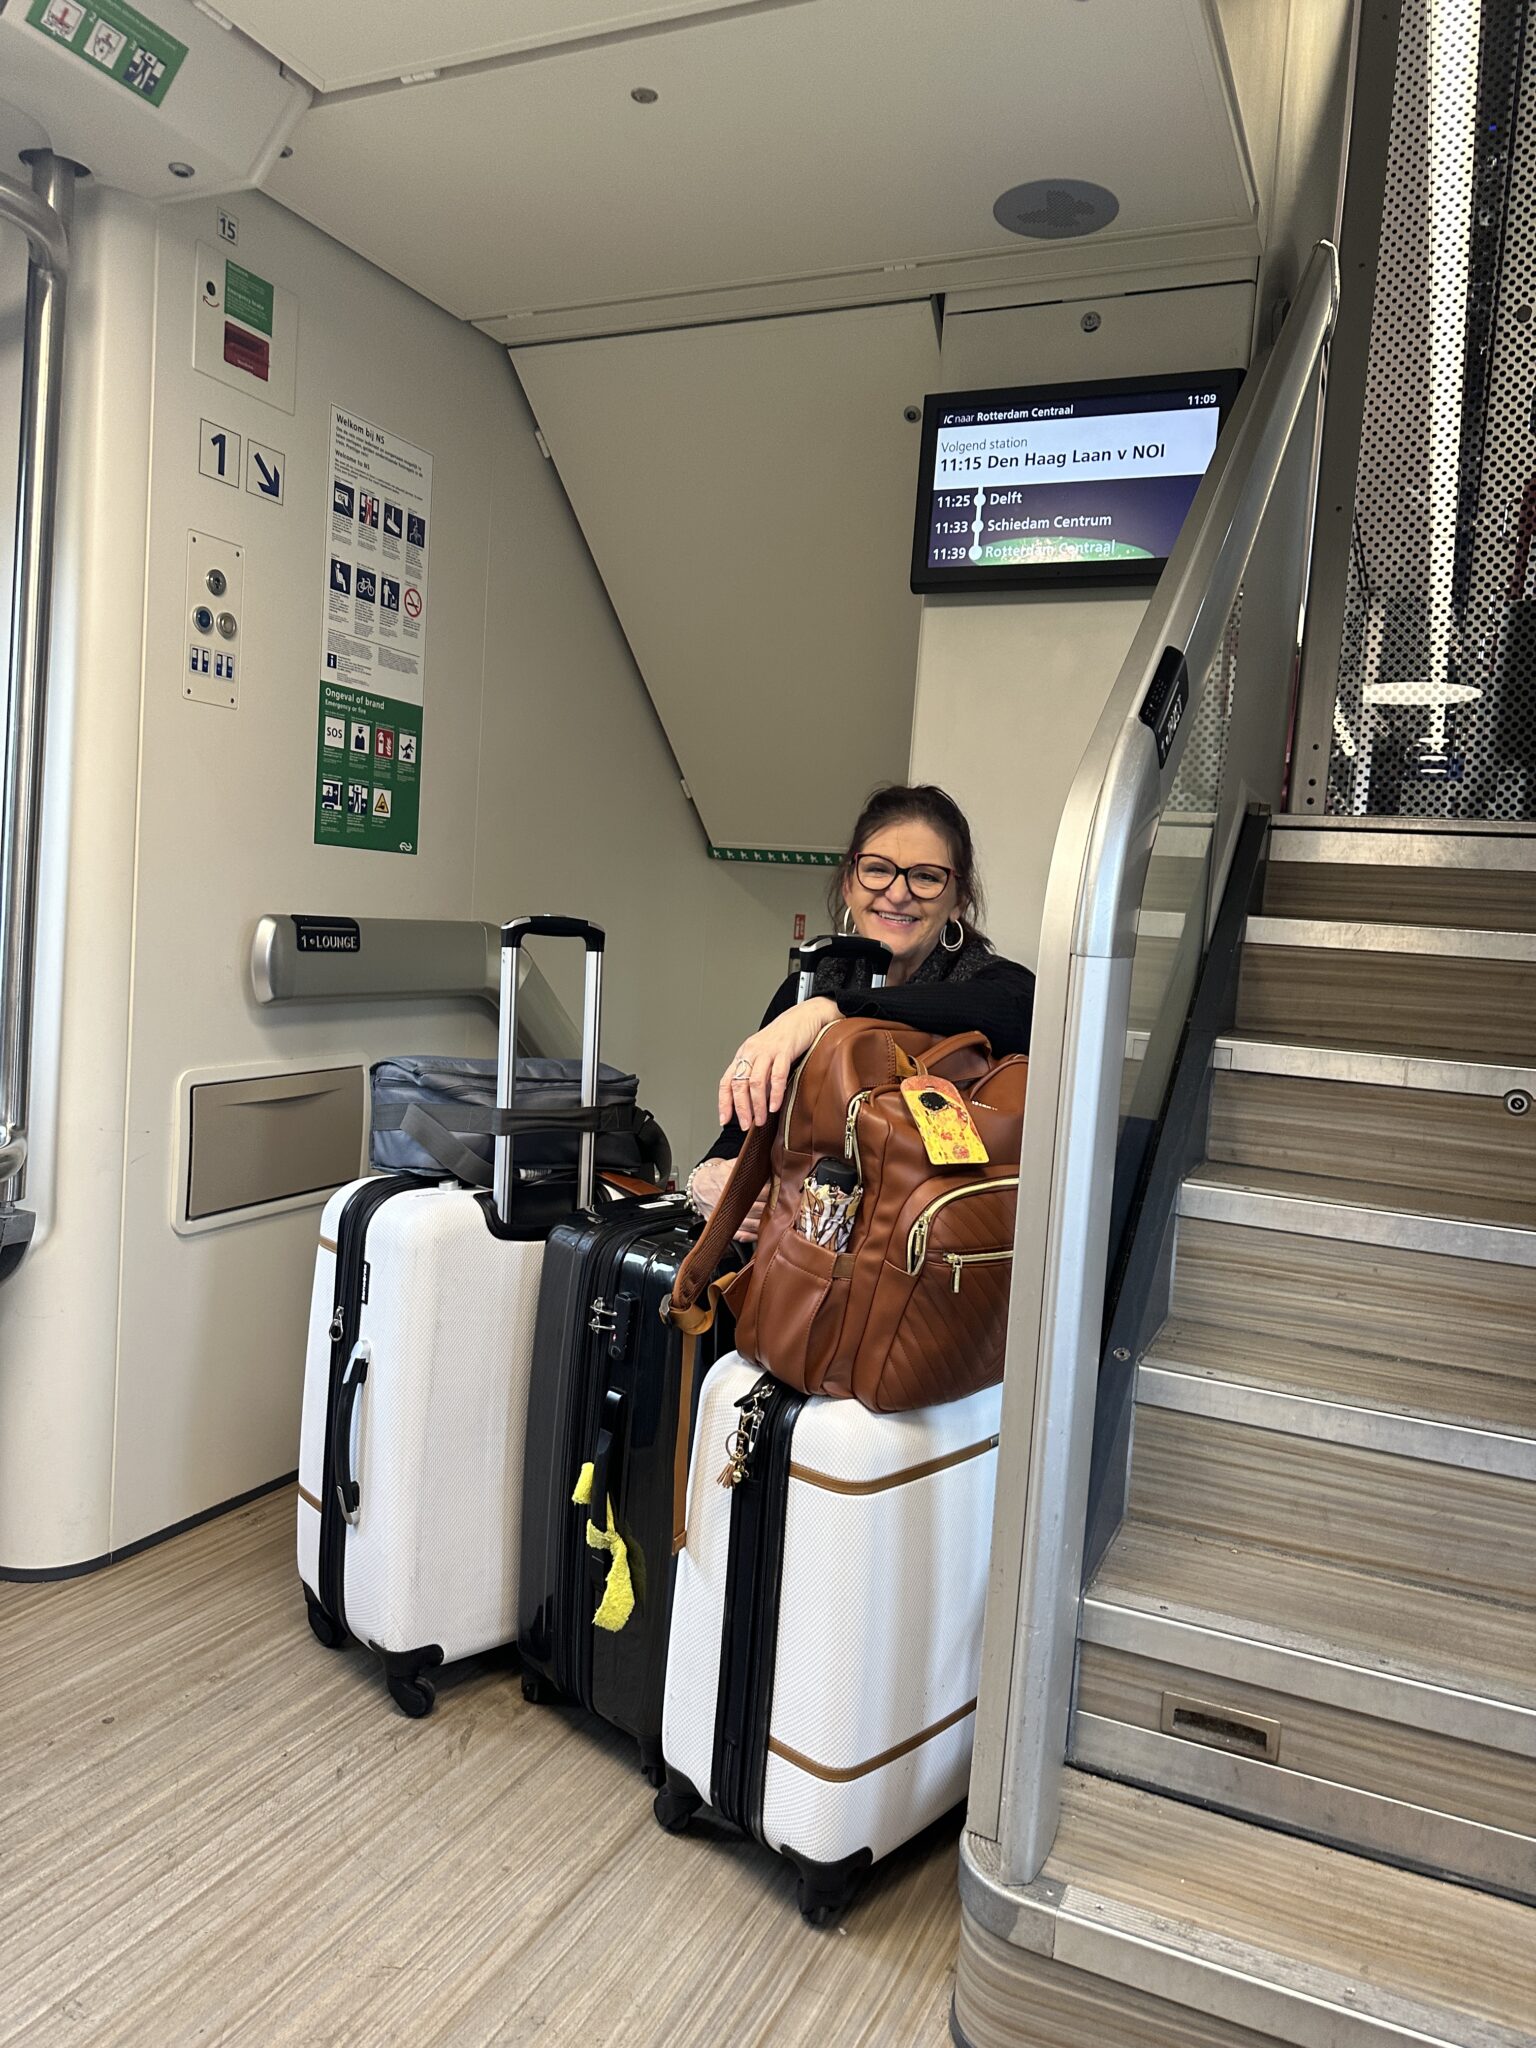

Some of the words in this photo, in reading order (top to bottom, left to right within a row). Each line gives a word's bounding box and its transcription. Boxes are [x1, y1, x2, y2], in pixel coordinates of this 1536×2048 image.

[220, 218, 236, 239] 15
[1188, 394, 1216, 405] 11:09
[944, 414, 953, 424] IC
[955, 414, 974, 423] naar
[977, 409, 1028, 422] Rotterdam
[1032, 405, 1073, 417] Centraal
[337, 414, 364, 434] Welkom
[366, 428, 374, 441] bij
[376, 434, 384, 444] NS
[211, 433, 226, 476] 1
[942, 439, 986, 454] Volgend
[990, 437, 1027, 450] station
[940, 457, 982, 472] 11:15
[988, 455, 1020, 469] Den
[1025, 452, 1066, 467] Haag
[1073, 449, 1111, 463] Laan
[1117, 450, 1126, 460] v
[1133, 444, 1165, 459] NOI
[937, 495, 970, 508] 11:25
[990, 493, 1022, 505] Delft
[935, 521, 968, 534] 11:33
[988, 517, 1049, 532] Schiedam
[1054, 515, 1112, 528] Centrum
[933, 548, 966, 560] 11:39
[985, 545, 1053, 558] Rotterdam
[1059, 540, 1116, 554] Centraal
[325, 700, 350, 711] Emergency
[326, 688, 354, 702] Ongeval
[356, 696, 363, 704] of
[366, 697, 384, 710] brand
[327, 727, 342, 738] SOS
[317, 936, 357, 948] LOUNGE
